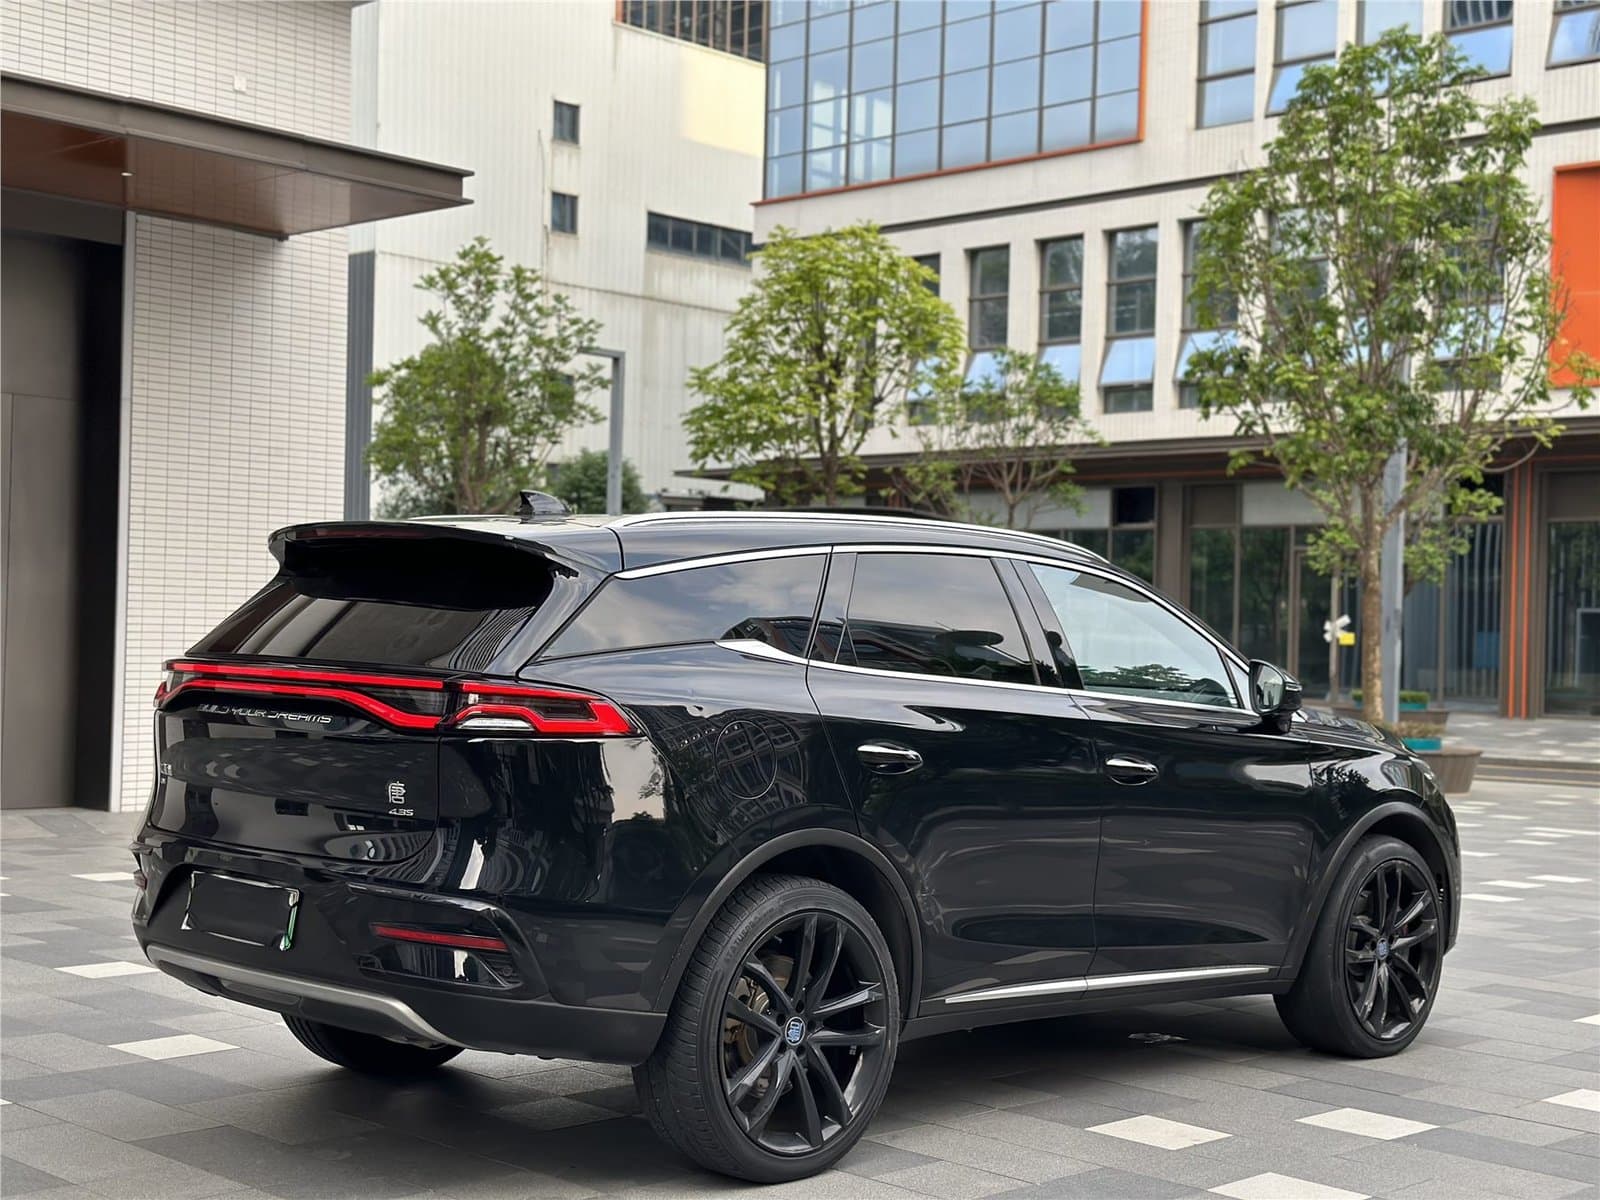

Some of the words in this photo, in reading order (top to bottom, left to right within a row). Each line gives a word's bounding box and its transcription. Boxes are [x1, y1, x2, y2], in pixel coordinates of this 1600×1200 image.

[231, 707, 267, 718] YOUR
[267, 710, 332, 724] DREAMS
[388, 780, 406, 804] 唐
